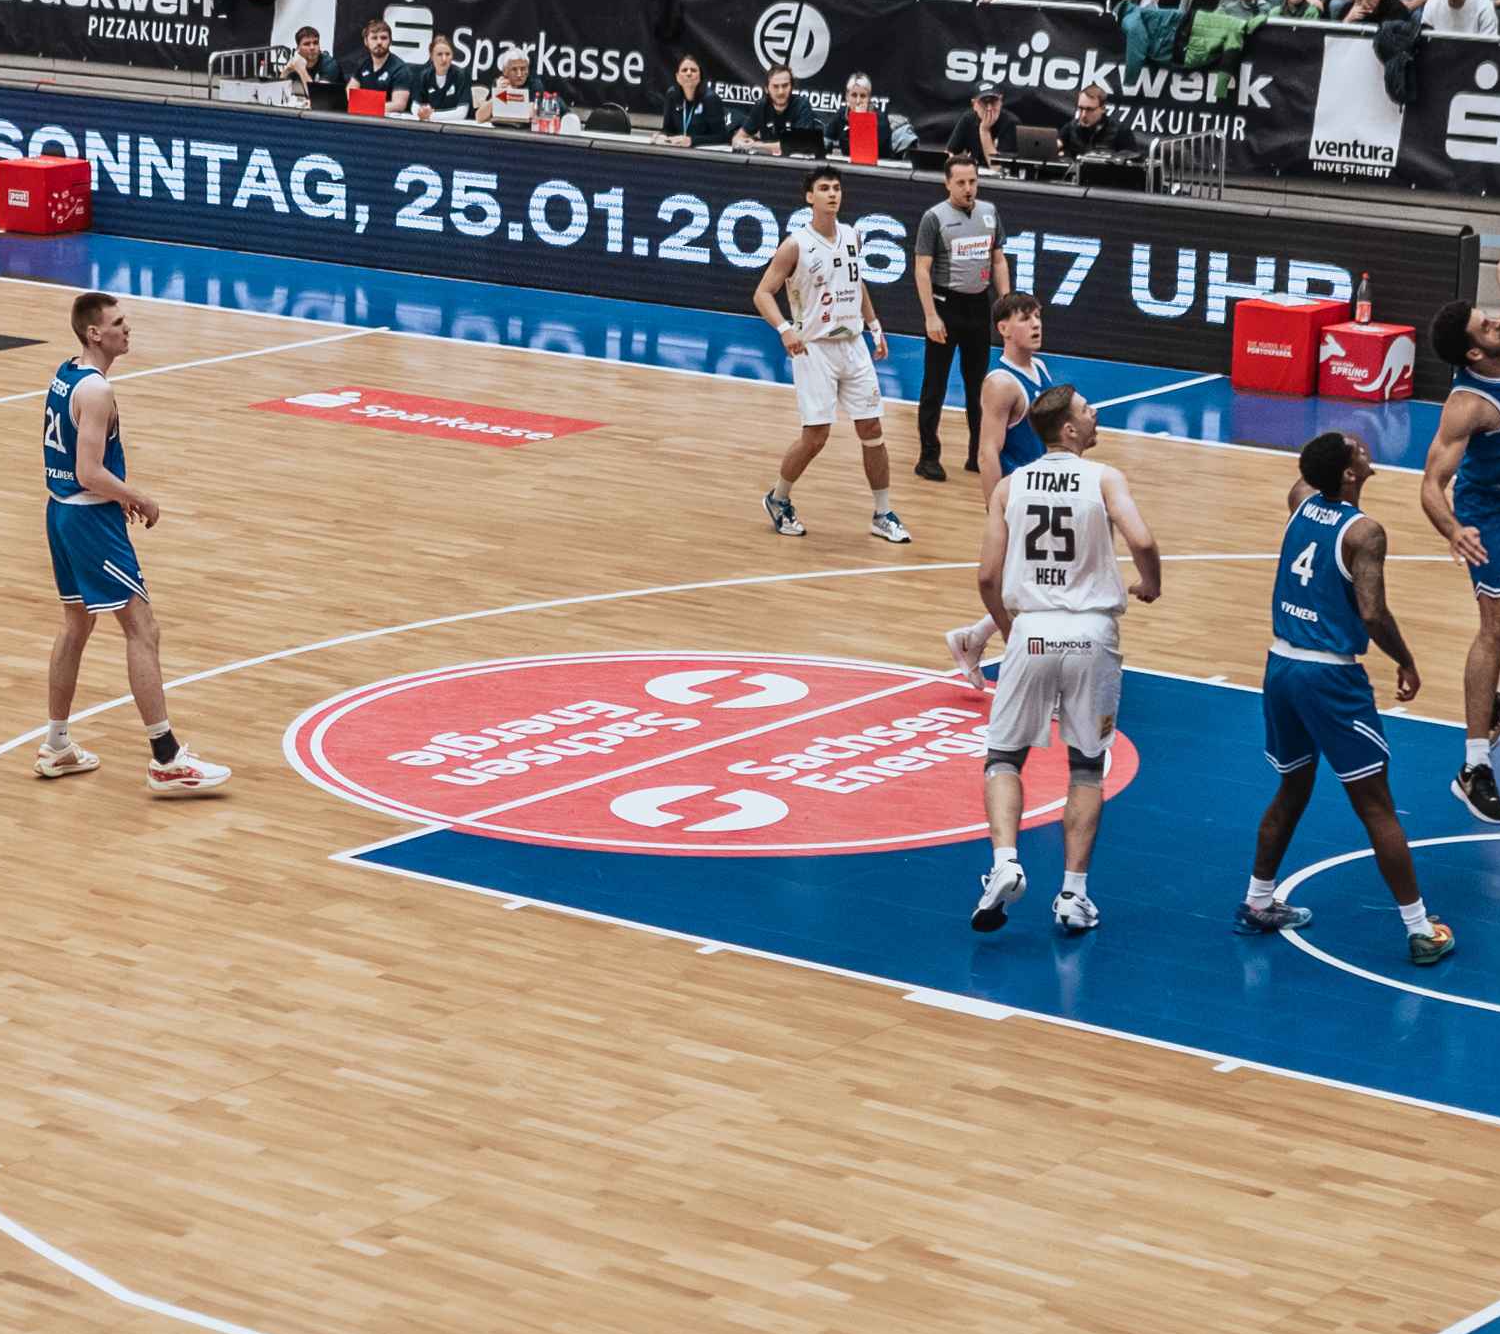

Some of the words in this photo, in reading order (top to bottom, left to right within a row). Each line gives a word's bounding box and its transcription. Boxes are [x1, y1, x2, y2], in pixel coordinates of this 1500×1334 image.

[88, 15, 210, 47] PIZZAKULTUR
[1314, 138, 1395, 164] ventura
[1312, 161, 1392, 179] INVESTMENT
[395, 163, 908, 284] 25.01.206
[1001, 229, 1103, 308] 17
[847, 262, 859, 283] 13
[1330, 365, 1370, 380] SPRUNG
[45, 406, 68, 455] 21
[350, 403, 554, 441] Sparkasse
[1026, 470, 1081, 493] TITANS
[1302, 502, 1343, 527] WATSON
[1025, 504, 1076, 562] 25
[1035, 567, 1067, 586] HECK
[1290, 541, 1318, 587] 4
[1045, 640, 1092, 650] MUNDUS
[387, 698, 640, 768] Energie
[727, 705, 984, 782] Sachsen
[432, 711, 701, 788] Sachsen
